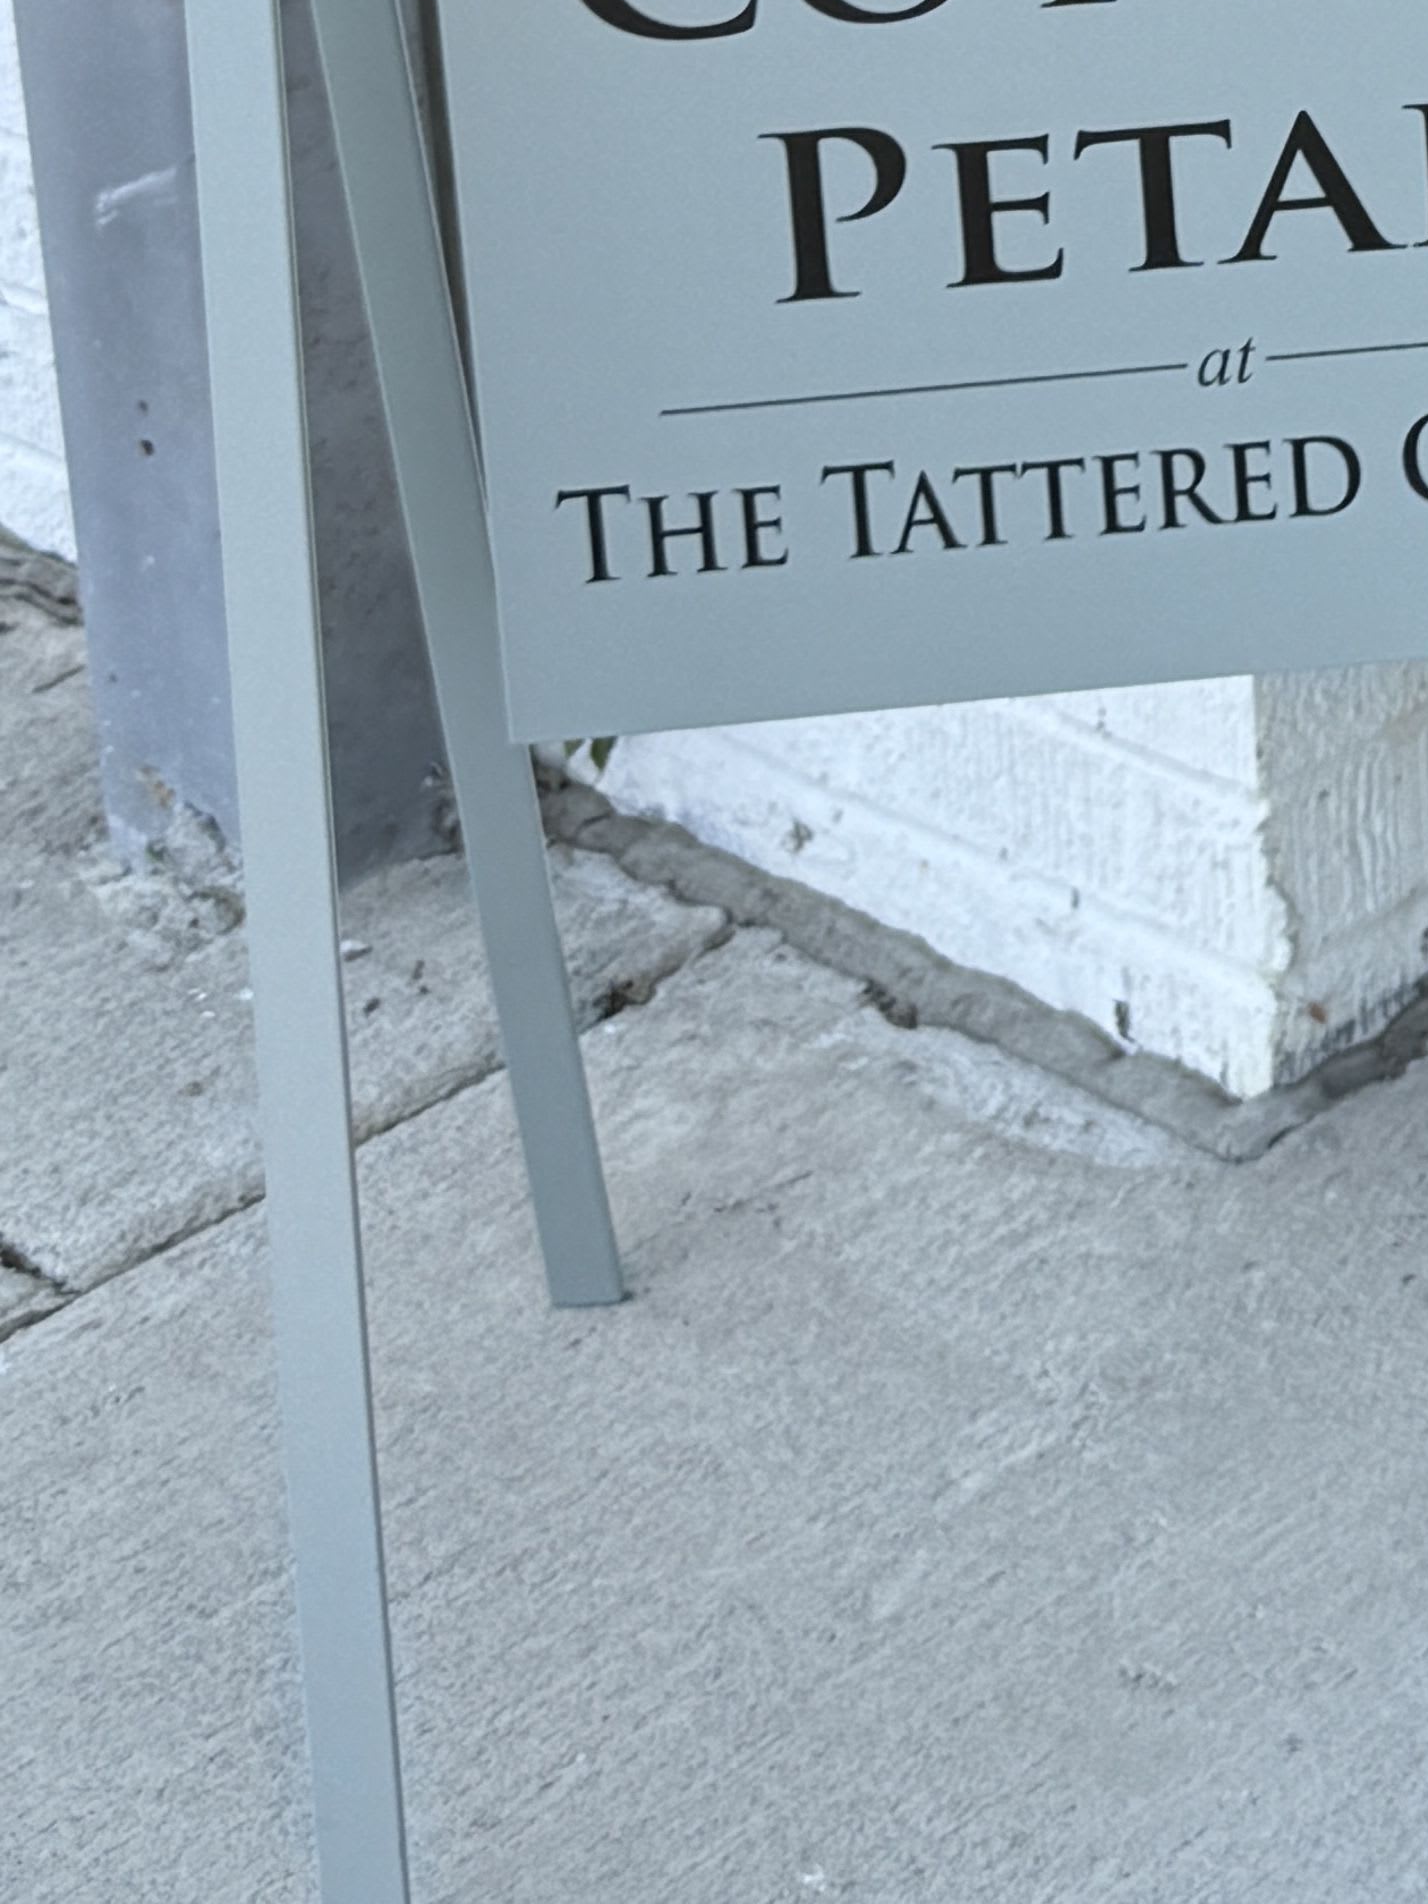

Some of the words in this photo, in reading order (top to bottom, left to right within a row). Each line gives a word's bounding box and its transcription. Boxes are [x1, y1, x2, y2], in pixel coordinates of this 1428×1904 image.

[1197, 336, 1256, 387] at
[555, 483, 790, 586] THE
[820, 434, 1363, 560] TATTERED
